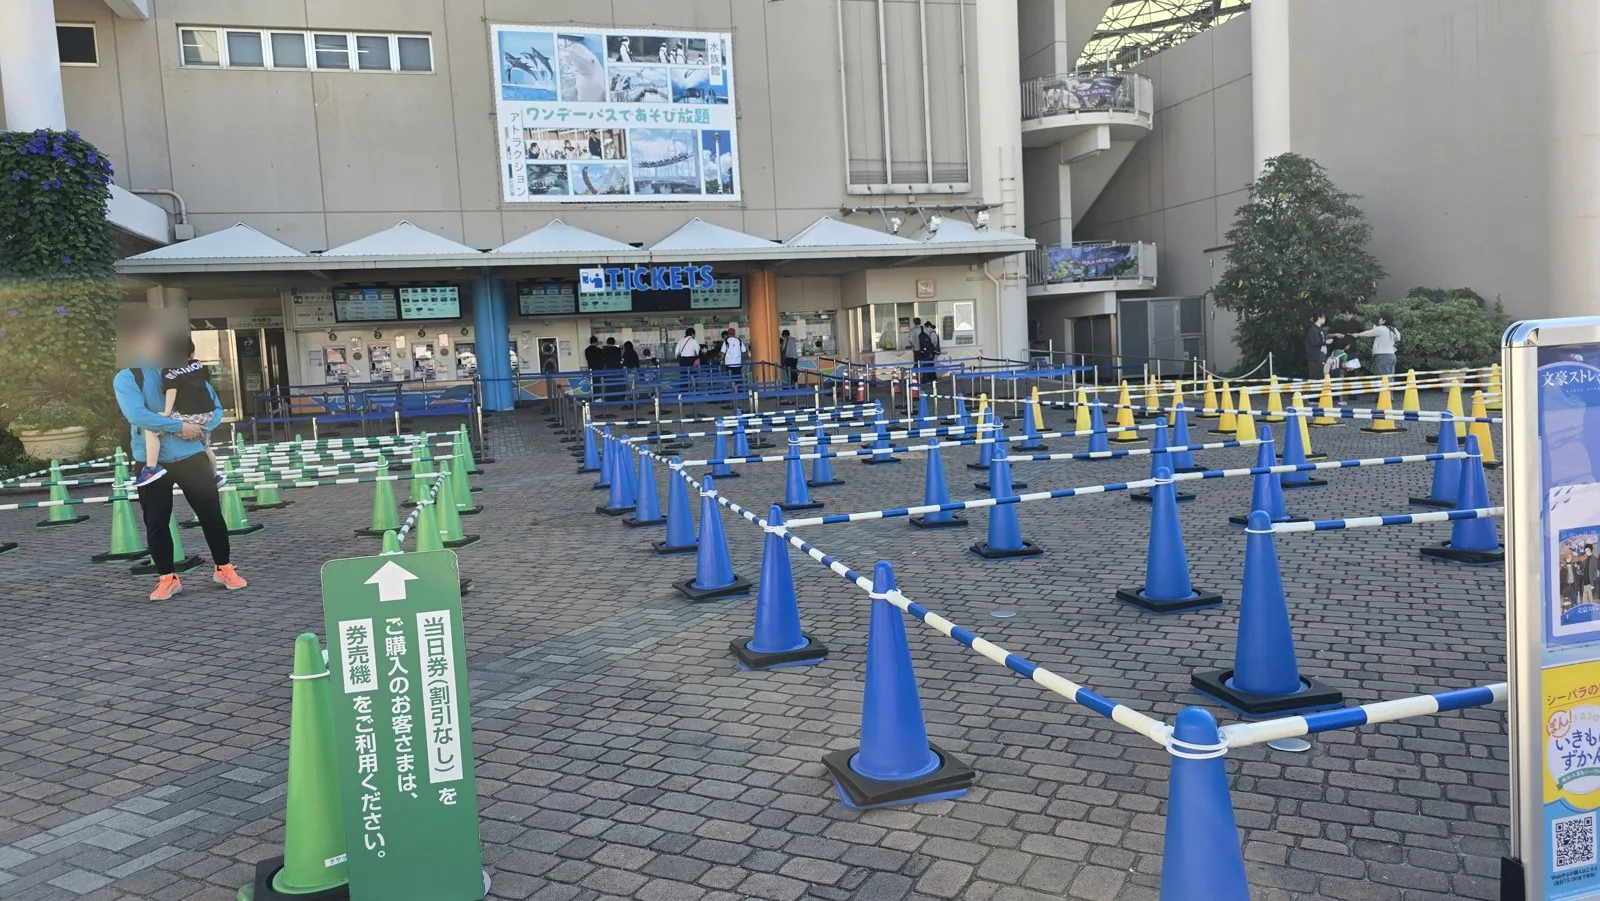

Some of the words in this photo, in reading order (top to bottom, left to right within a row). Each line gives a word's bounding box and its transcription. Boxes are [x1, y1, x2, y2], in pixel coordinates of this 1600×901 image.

[709, 41, 721, 77] 水族館
[526, 107, 710, 125] ワンデーパスであそび放題
[509, 112, 526, 197] アトラクション
[606, 265, 714, 291] TICKETS
[1547, 684, 1600, 706] シーパラの
[1556, 728, 1600, 751] いきも
